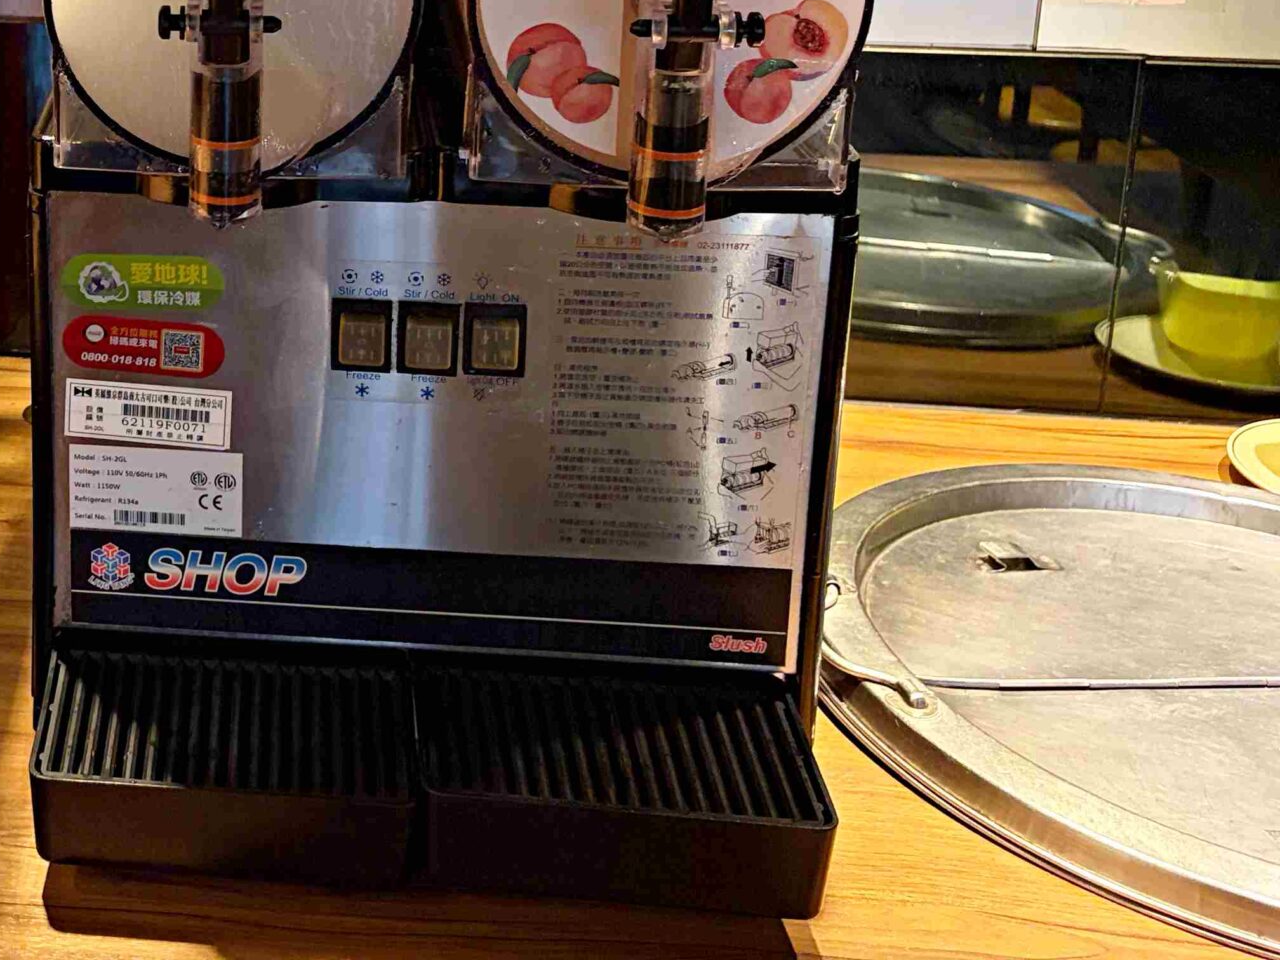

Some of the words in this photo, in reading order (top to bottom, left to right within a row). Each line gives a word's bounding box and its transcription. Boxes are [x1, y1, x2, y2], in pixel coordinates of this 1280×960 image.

[697, 242, 750, 250] 02-23111877
[130, 262, 208, 285] 愛地球!
[338, 287, 357, 296] Stir
[365, 288, 388, 297] Cold
[404, 290, 422, 298] Stir
[431, 291, 455, 300] Cold
[137, 290, 201, 306] 環保冷媒
[470, 293, 496, 302] Light
[501, 294, 520, 302] ON
[81, 351, 157, 367] 0800-018-818
[345, 371, 381, 381] Freeze
[411, 374, 447, 384] Freeze
[496, 377, 519, 386] OFF
[121, 416, 207, 433] 62119F0071
[74, 453, 95, 461] Model
[74, 468, 100, 476] Voltage
[124, 470, 153, 478] 50/60Hz
[74, 481, 91, 489] Watt
[97, 482, 121, 490] 1150W
[74, 495, 112, 504] Refrigerant
[144, 547, 308, 596] SHOP
[709, 634, 768, 654] Slush
